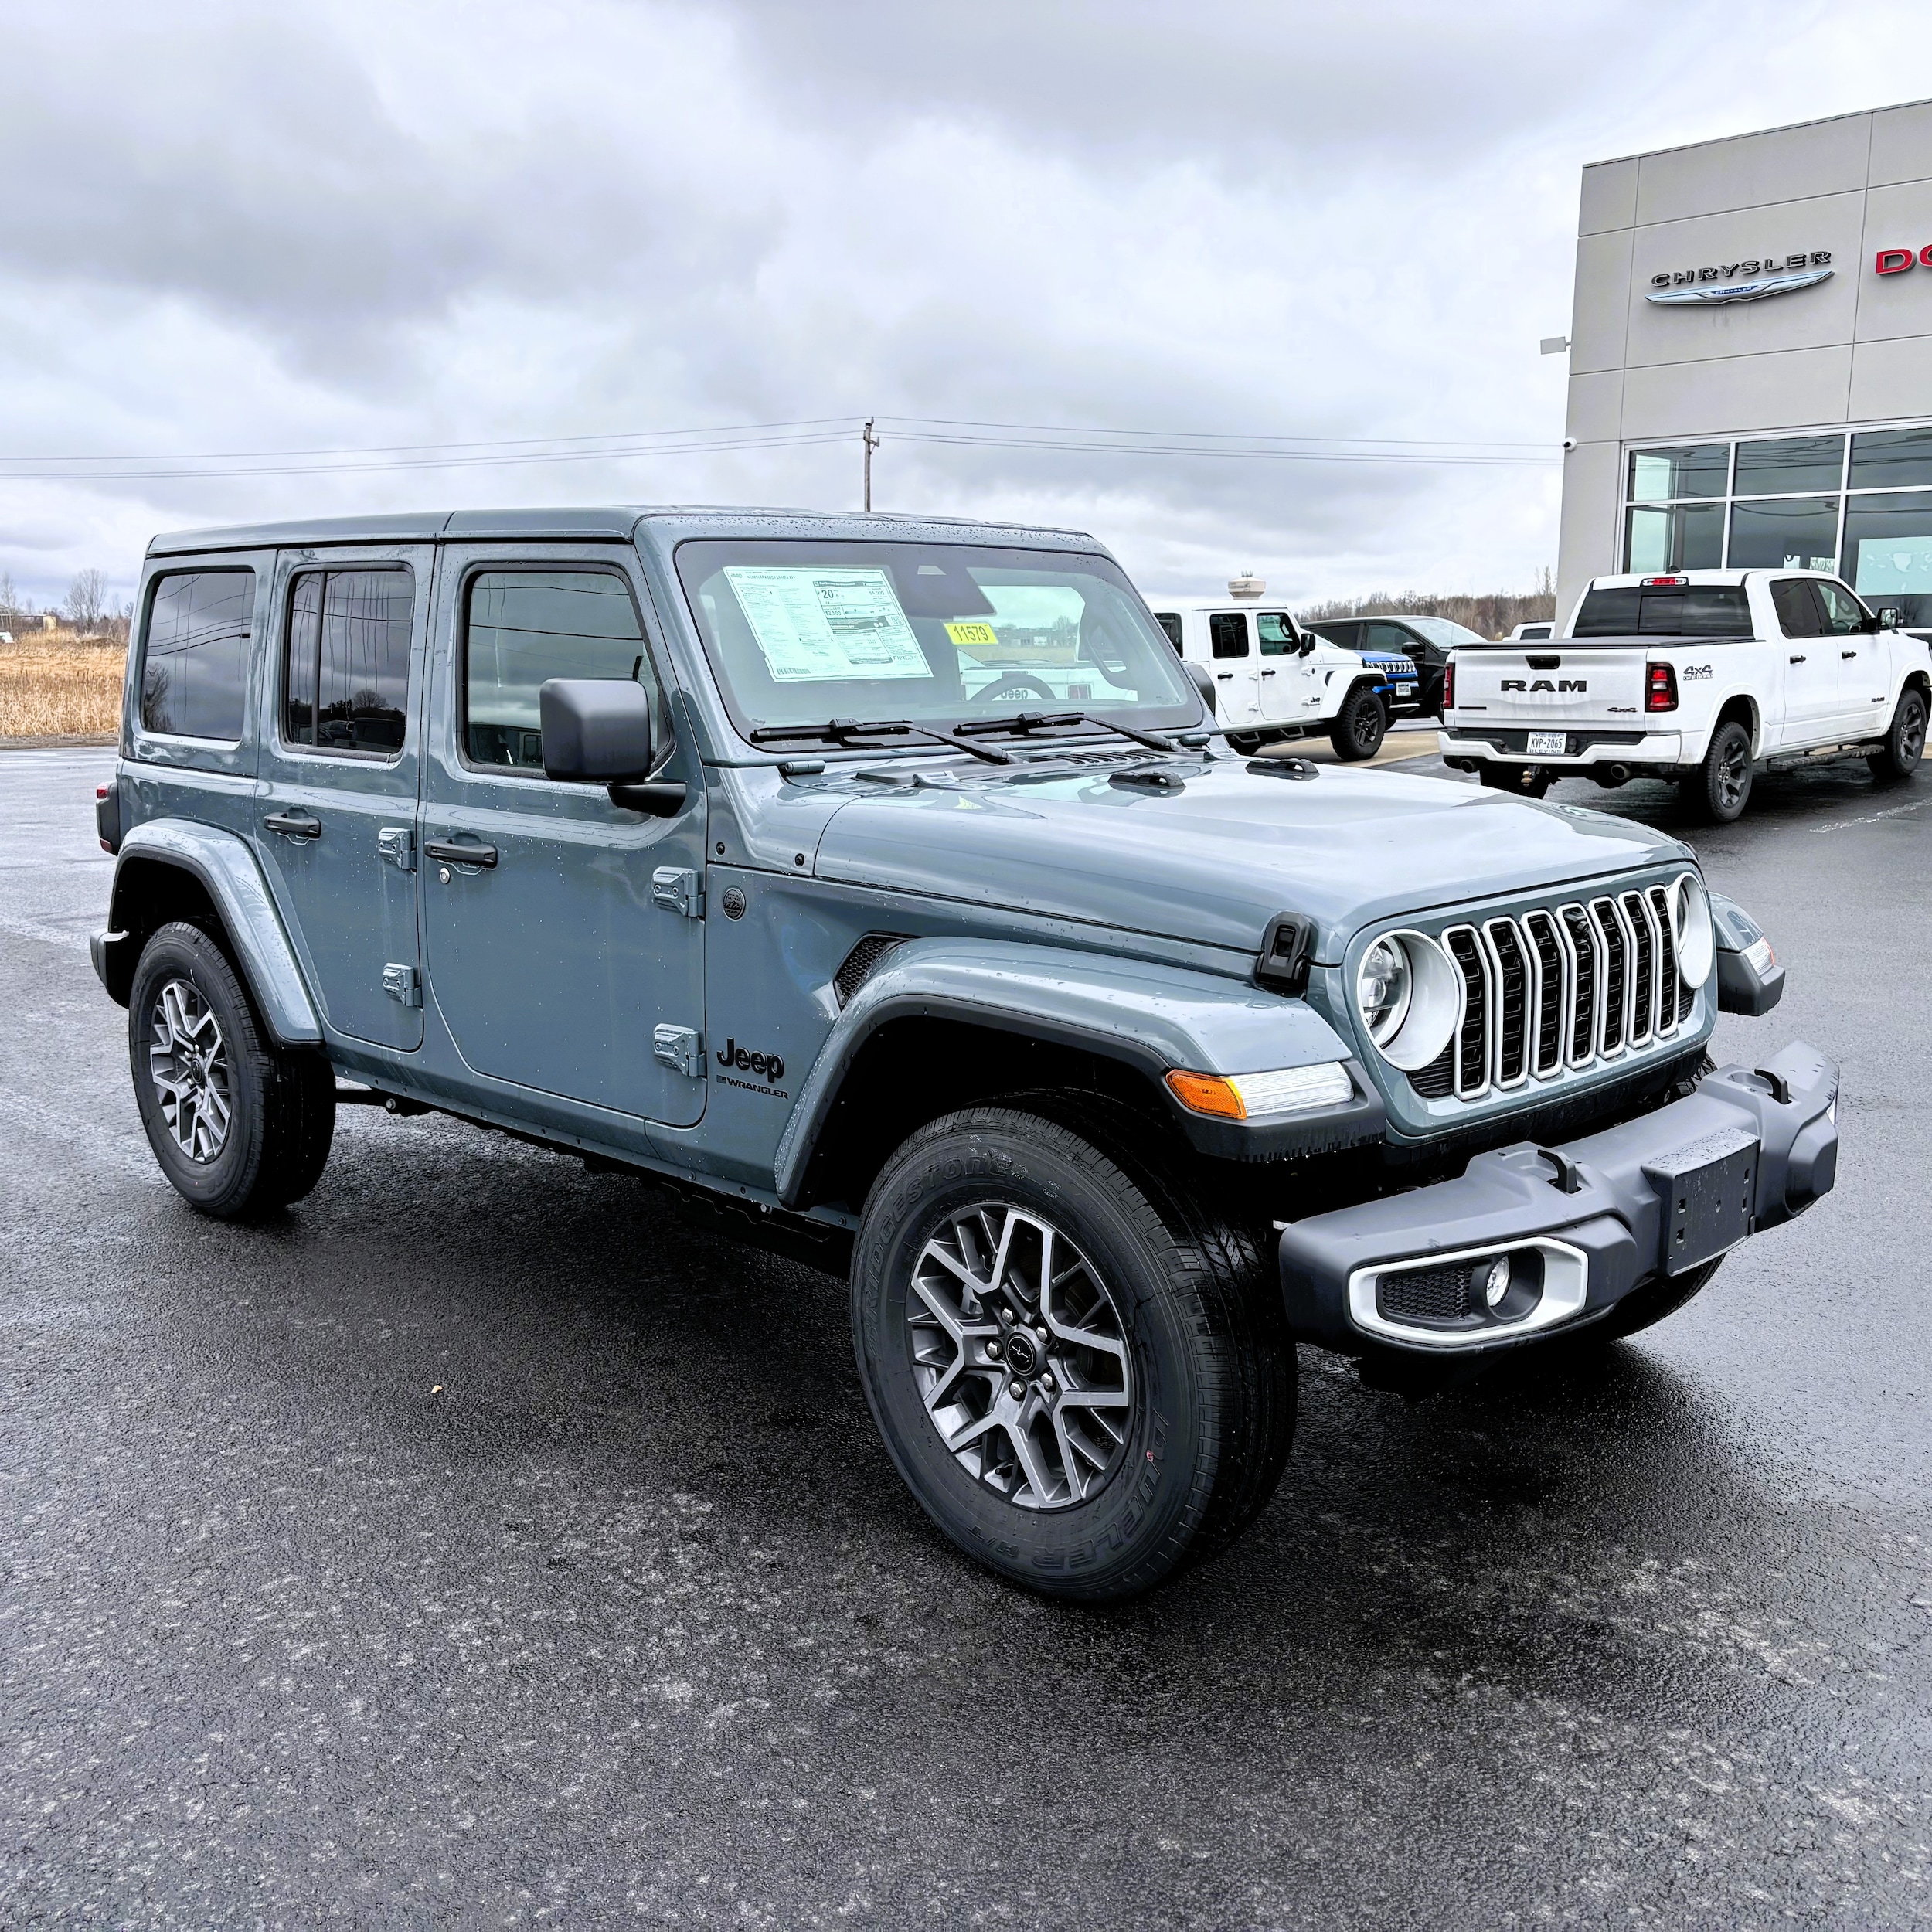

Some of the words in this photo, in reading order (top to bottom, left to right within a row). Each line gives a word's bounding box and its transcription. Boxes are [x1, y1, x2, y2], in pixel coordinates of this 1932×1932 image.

[1651, 251, 1832, 287] CHRYSLER
[821, 590, 833, 599] 20
[954, 625, 989, 641] 11579
[1501, 680, 1587, 692] RAM
[717, 1037, 784, 1083] Jeep
[726, 1077, 788, 1100] WRANGLER
